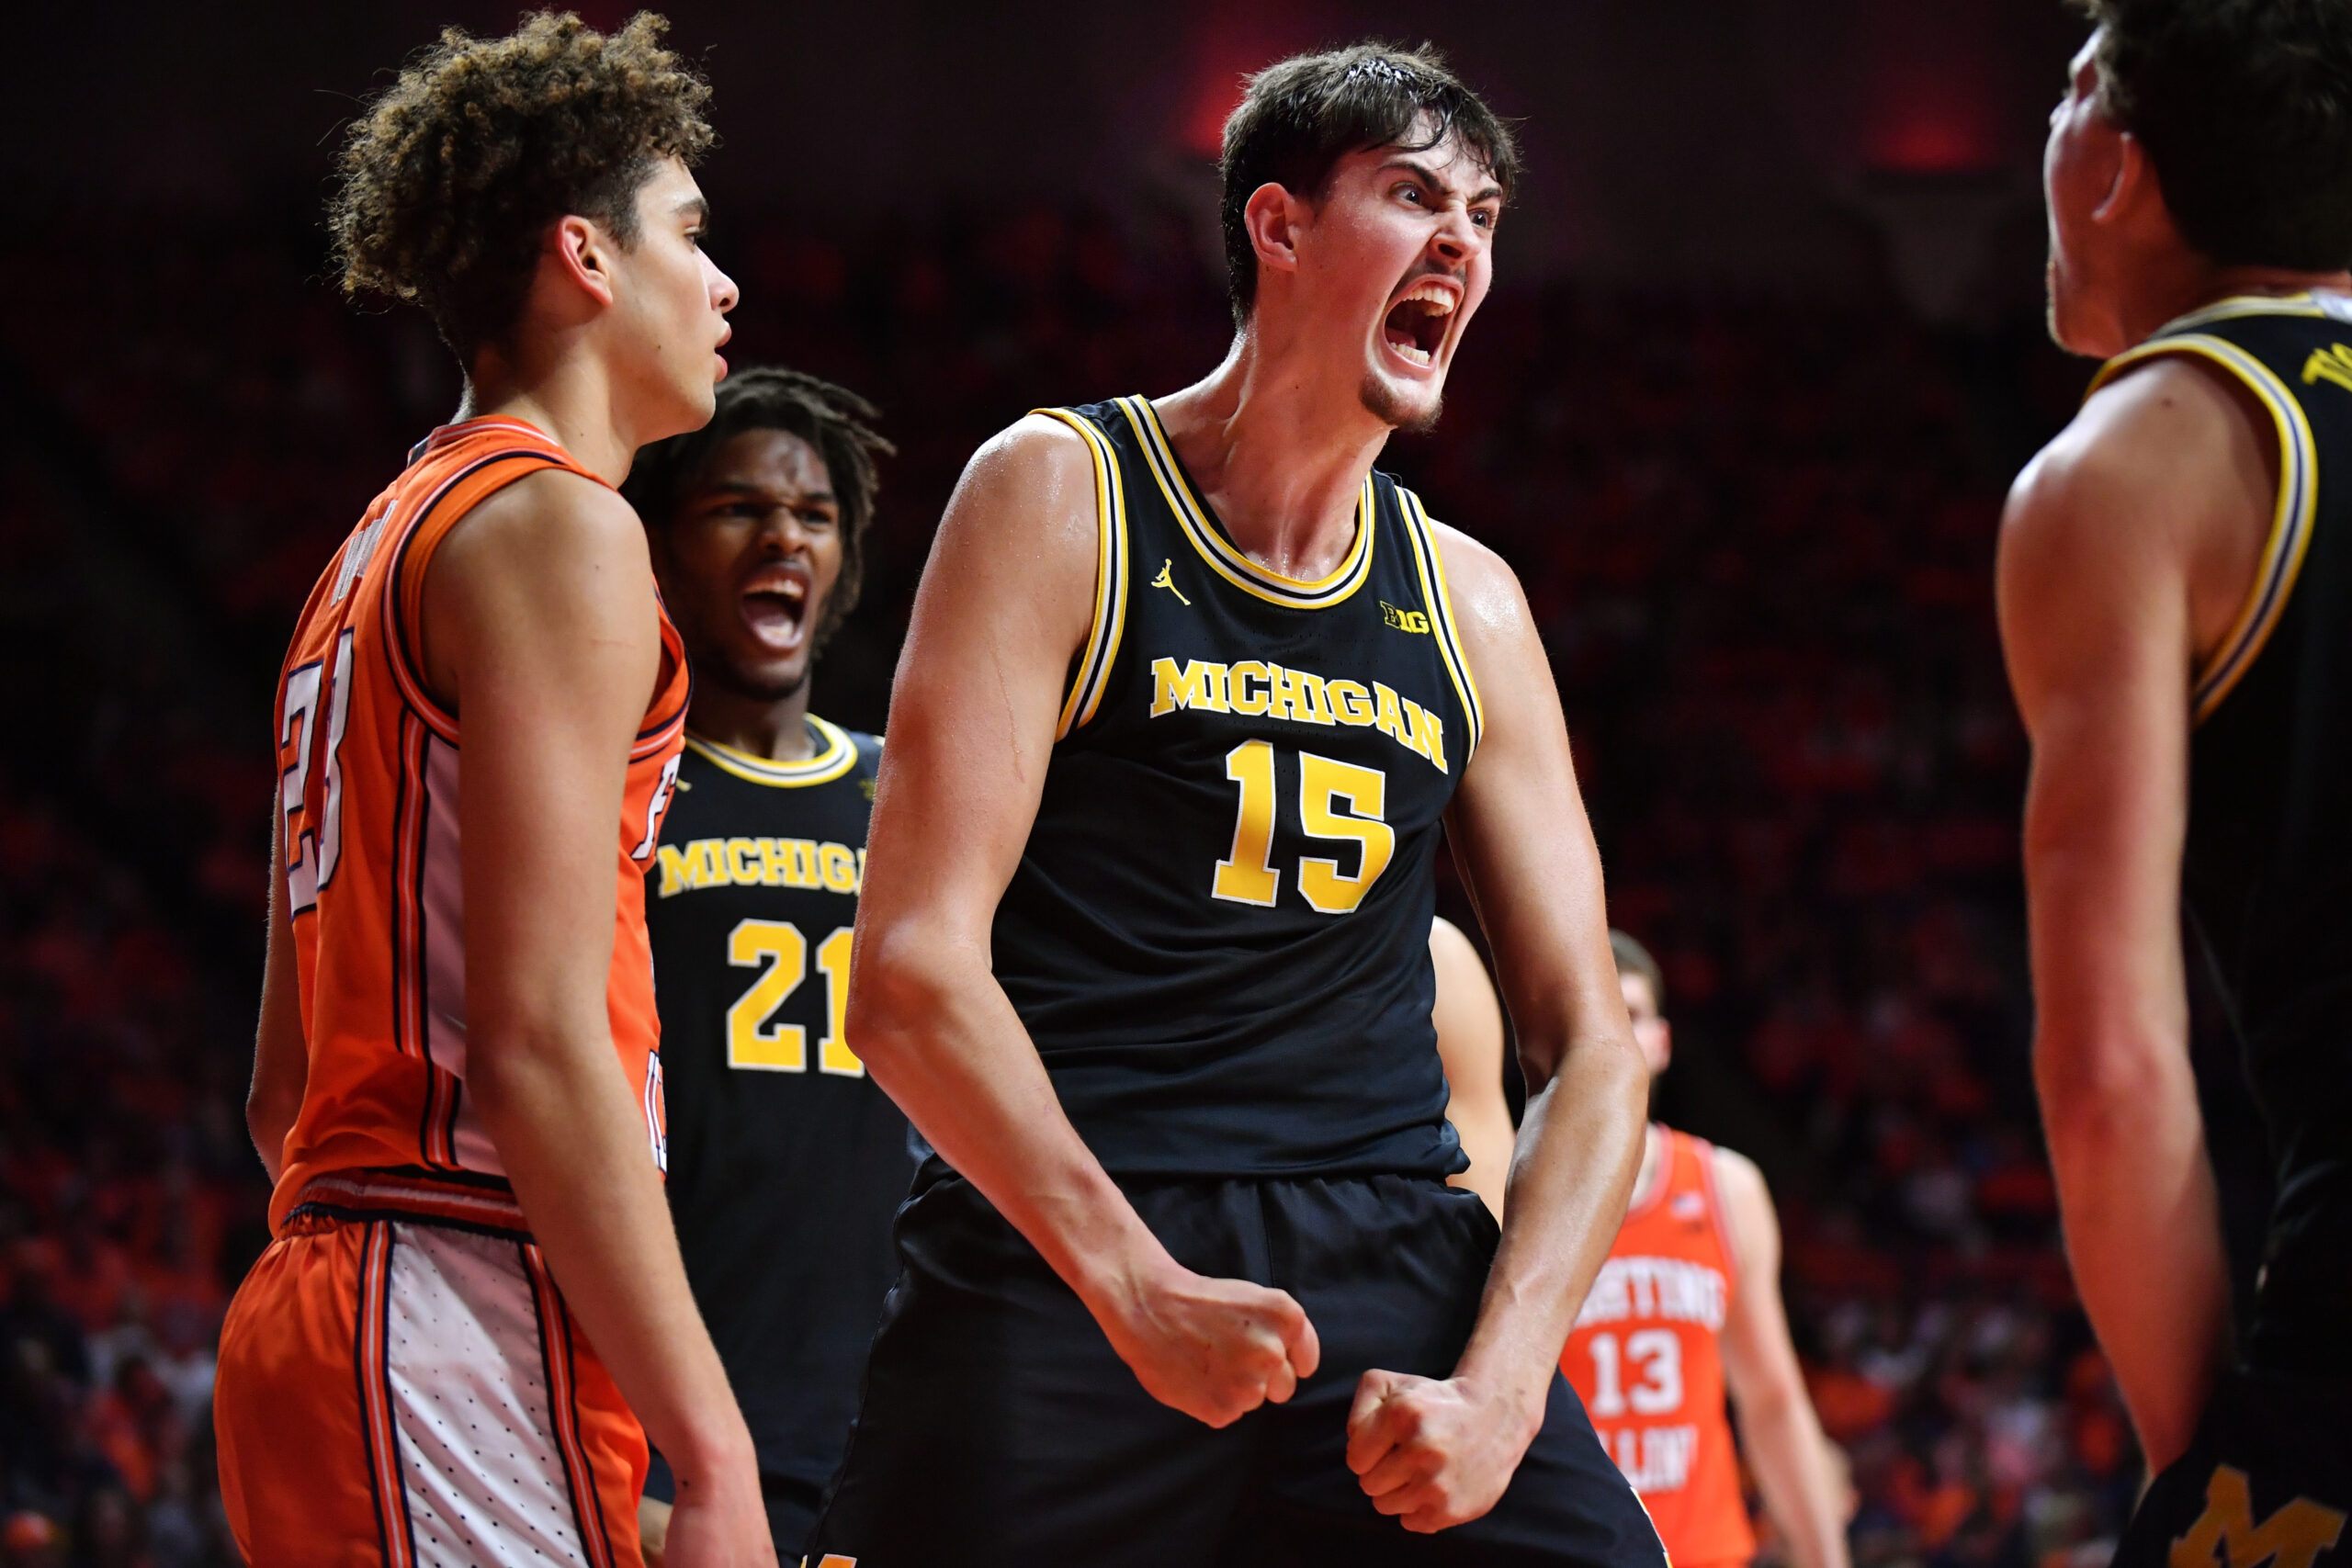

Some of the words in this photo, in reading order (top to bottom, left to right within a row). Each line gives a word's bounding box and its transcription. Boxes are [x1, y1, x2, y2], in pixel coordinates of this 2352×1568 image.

[1150, 657, 1449, 775] MICHIGAN
[657, 837, 866, 898] MICHIG
[1211, 739, 1396, 915] 15
[727, 918, 865, 1077] 21
[1588, 1327, 1685, 1417] 13
